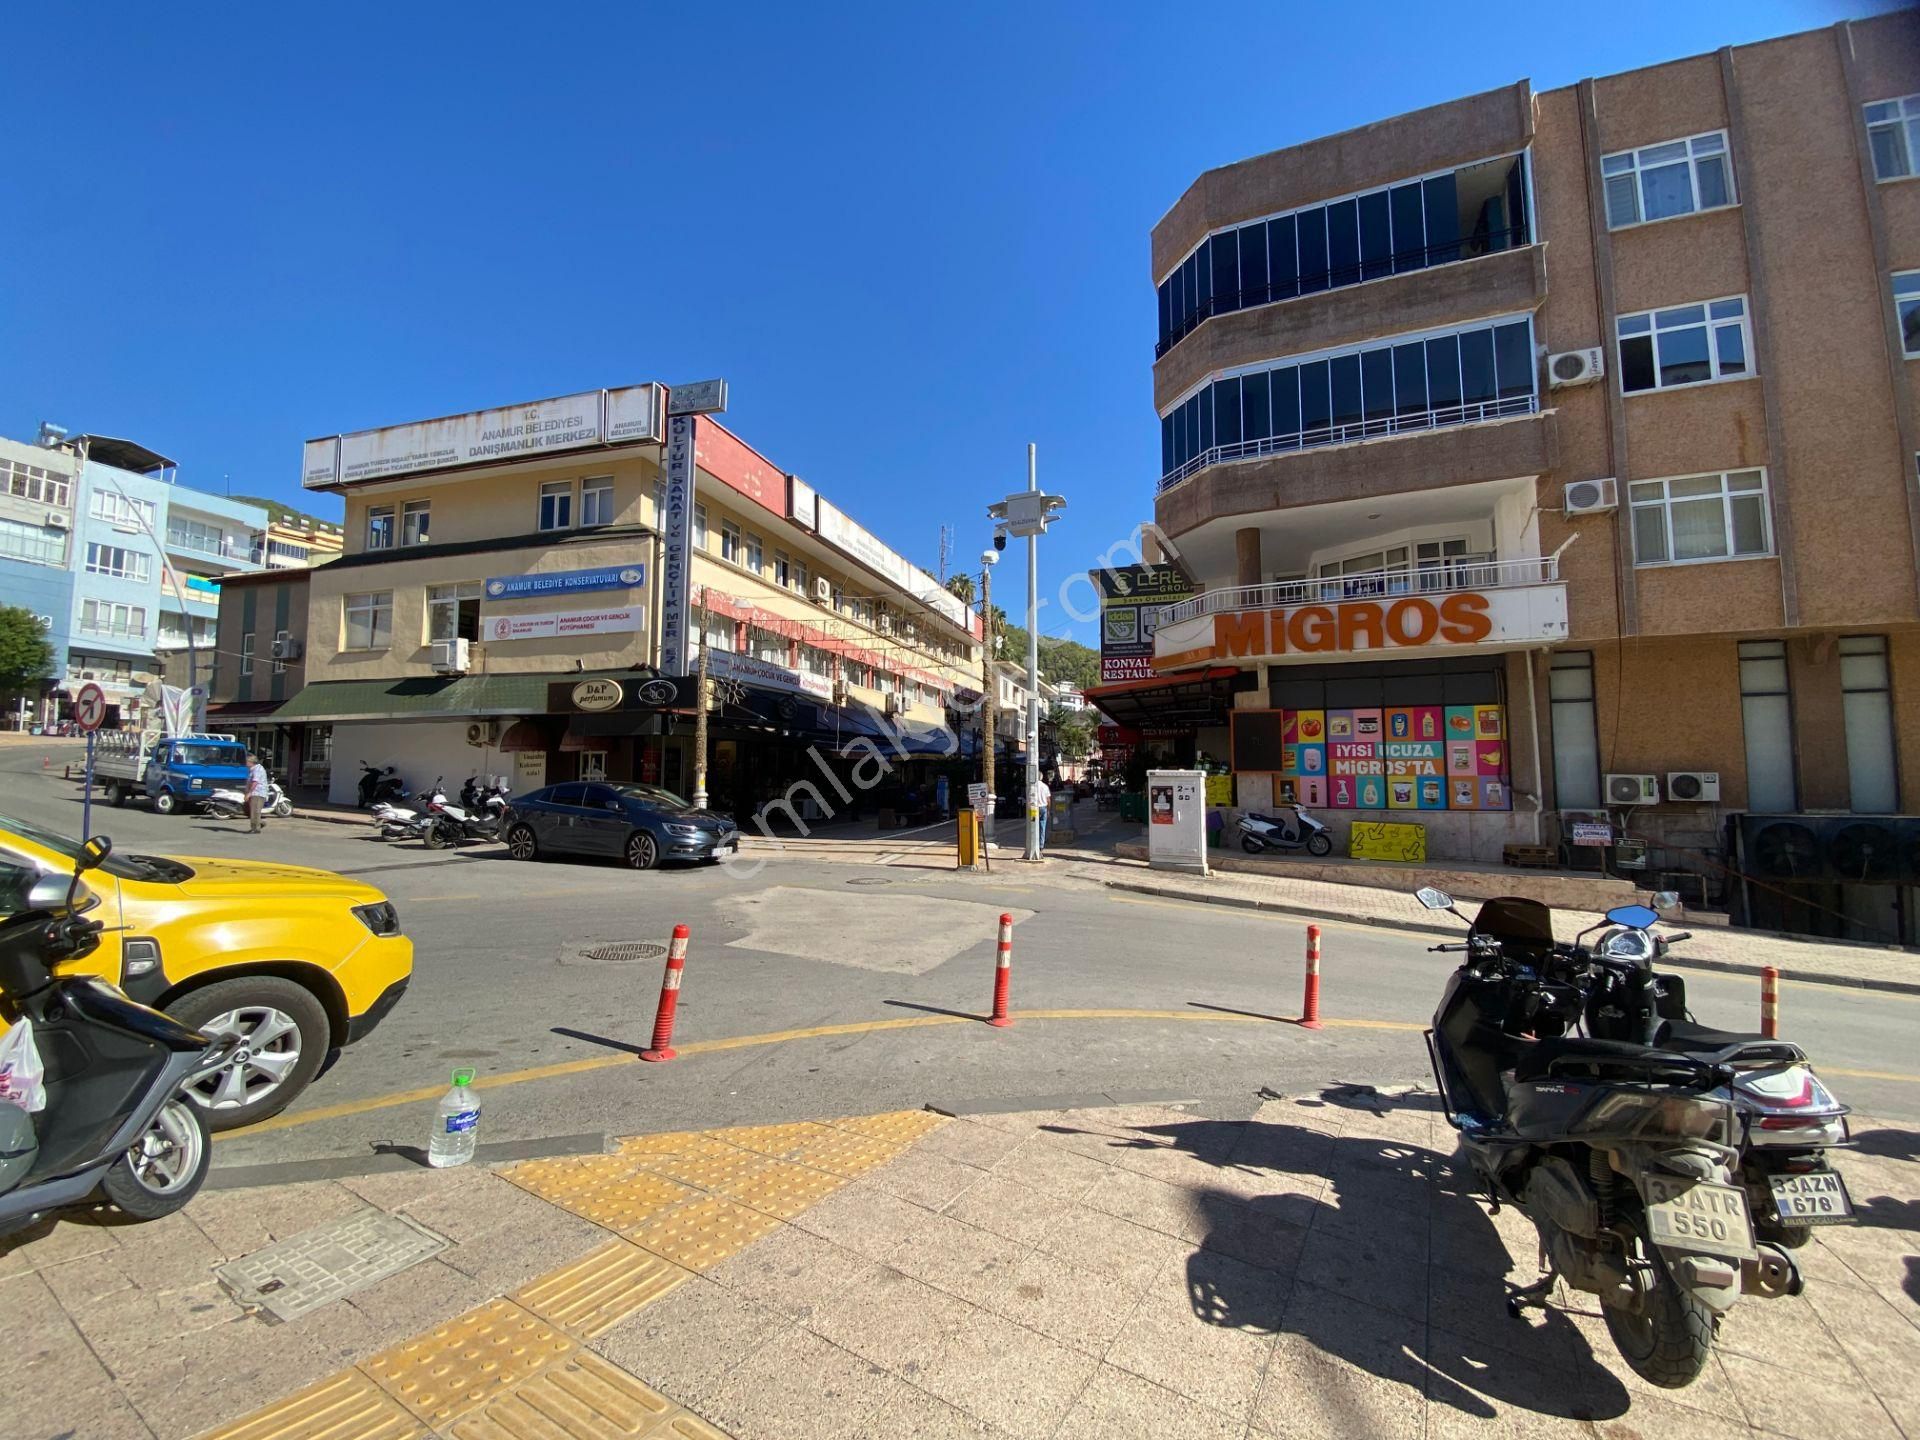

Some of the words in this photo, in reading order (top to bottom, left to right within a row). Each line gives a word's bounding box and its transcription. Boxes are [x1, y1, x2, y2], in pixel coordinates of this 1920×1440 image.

[481, 424, 524, 442] ANAMUR
[614, 420, 642, 430] ANAMUR
[469, 436, 544, 458] DANIŞMANLIK
[670, 477, 683, 519] SANAT
[506, 580, 531, 592] ANAMUR
[1137, 570, 1183, 587] CERE
[559, 616, 582, 624] ANAMUR
[1104, 657, 1151, 669] KONYAL
[586, 684, 607, 694] D&P
[579, 694, 614, 704] perfumum
[1379, 744, 1434, 757] UCUZA
[1773, 1176, 1839, 1194] 33AZN
[1651, 1179, 1741, 1217] 33ATR
[1792, 1196, 1833, 1213] 678
[1674, 1210, 1728, 1241] 550
